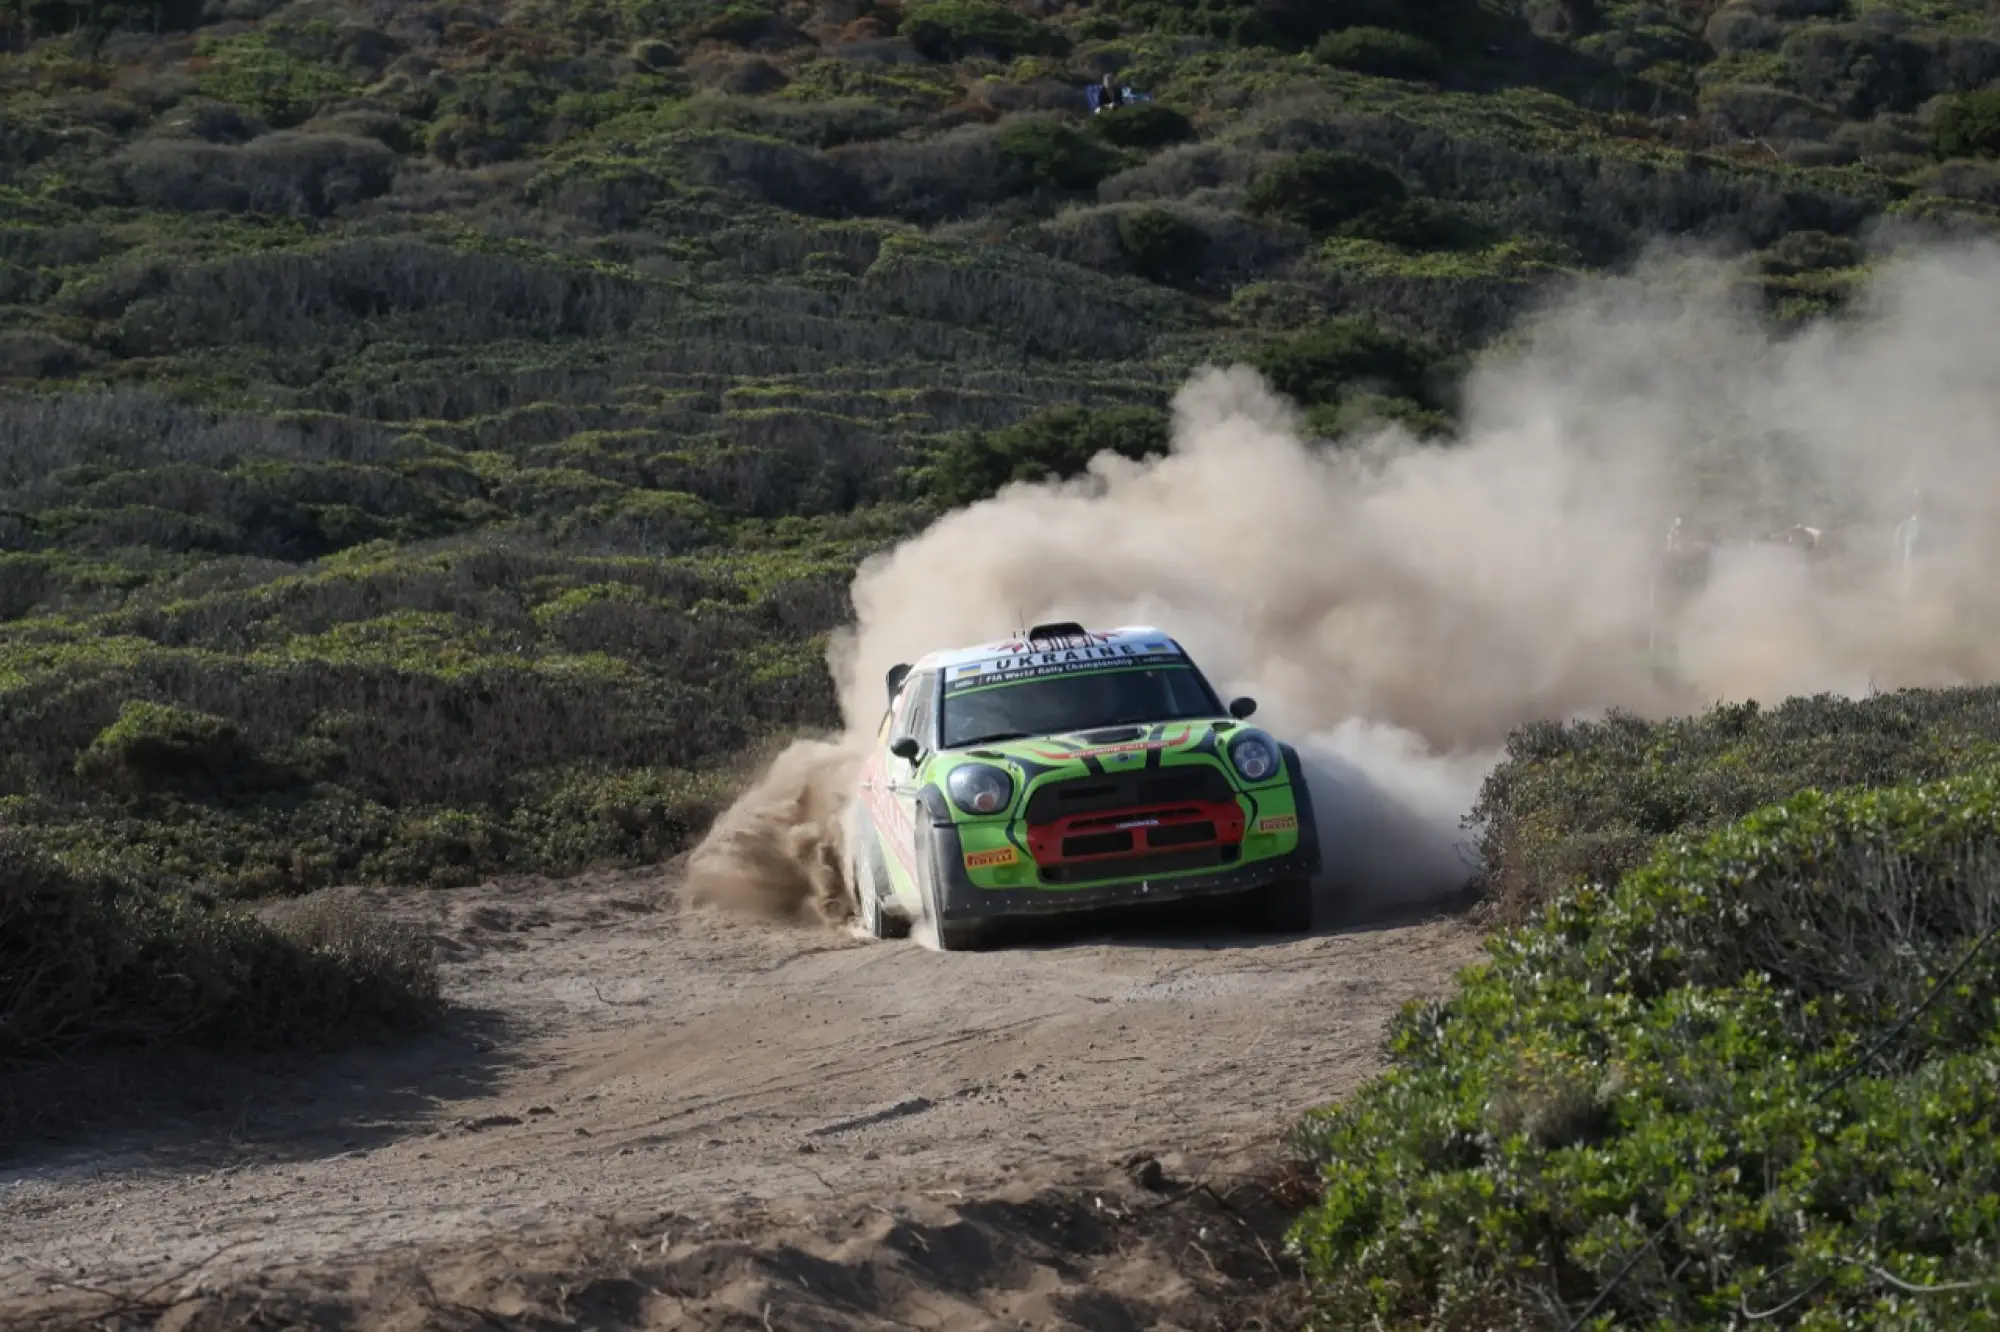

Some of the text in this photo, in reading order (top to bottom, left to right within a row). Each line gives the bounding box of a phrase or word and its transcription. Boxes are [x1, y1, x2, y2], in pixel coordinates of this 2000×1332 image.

[996, 643, 1136, 670] UKRAINE
[1005, 668, 1035, 681] World
[1039, 664, 1063, 676] Rally
[1065, 658, 1134, 670] Championship
[967, 848, 1011, 867] PIRELLI
